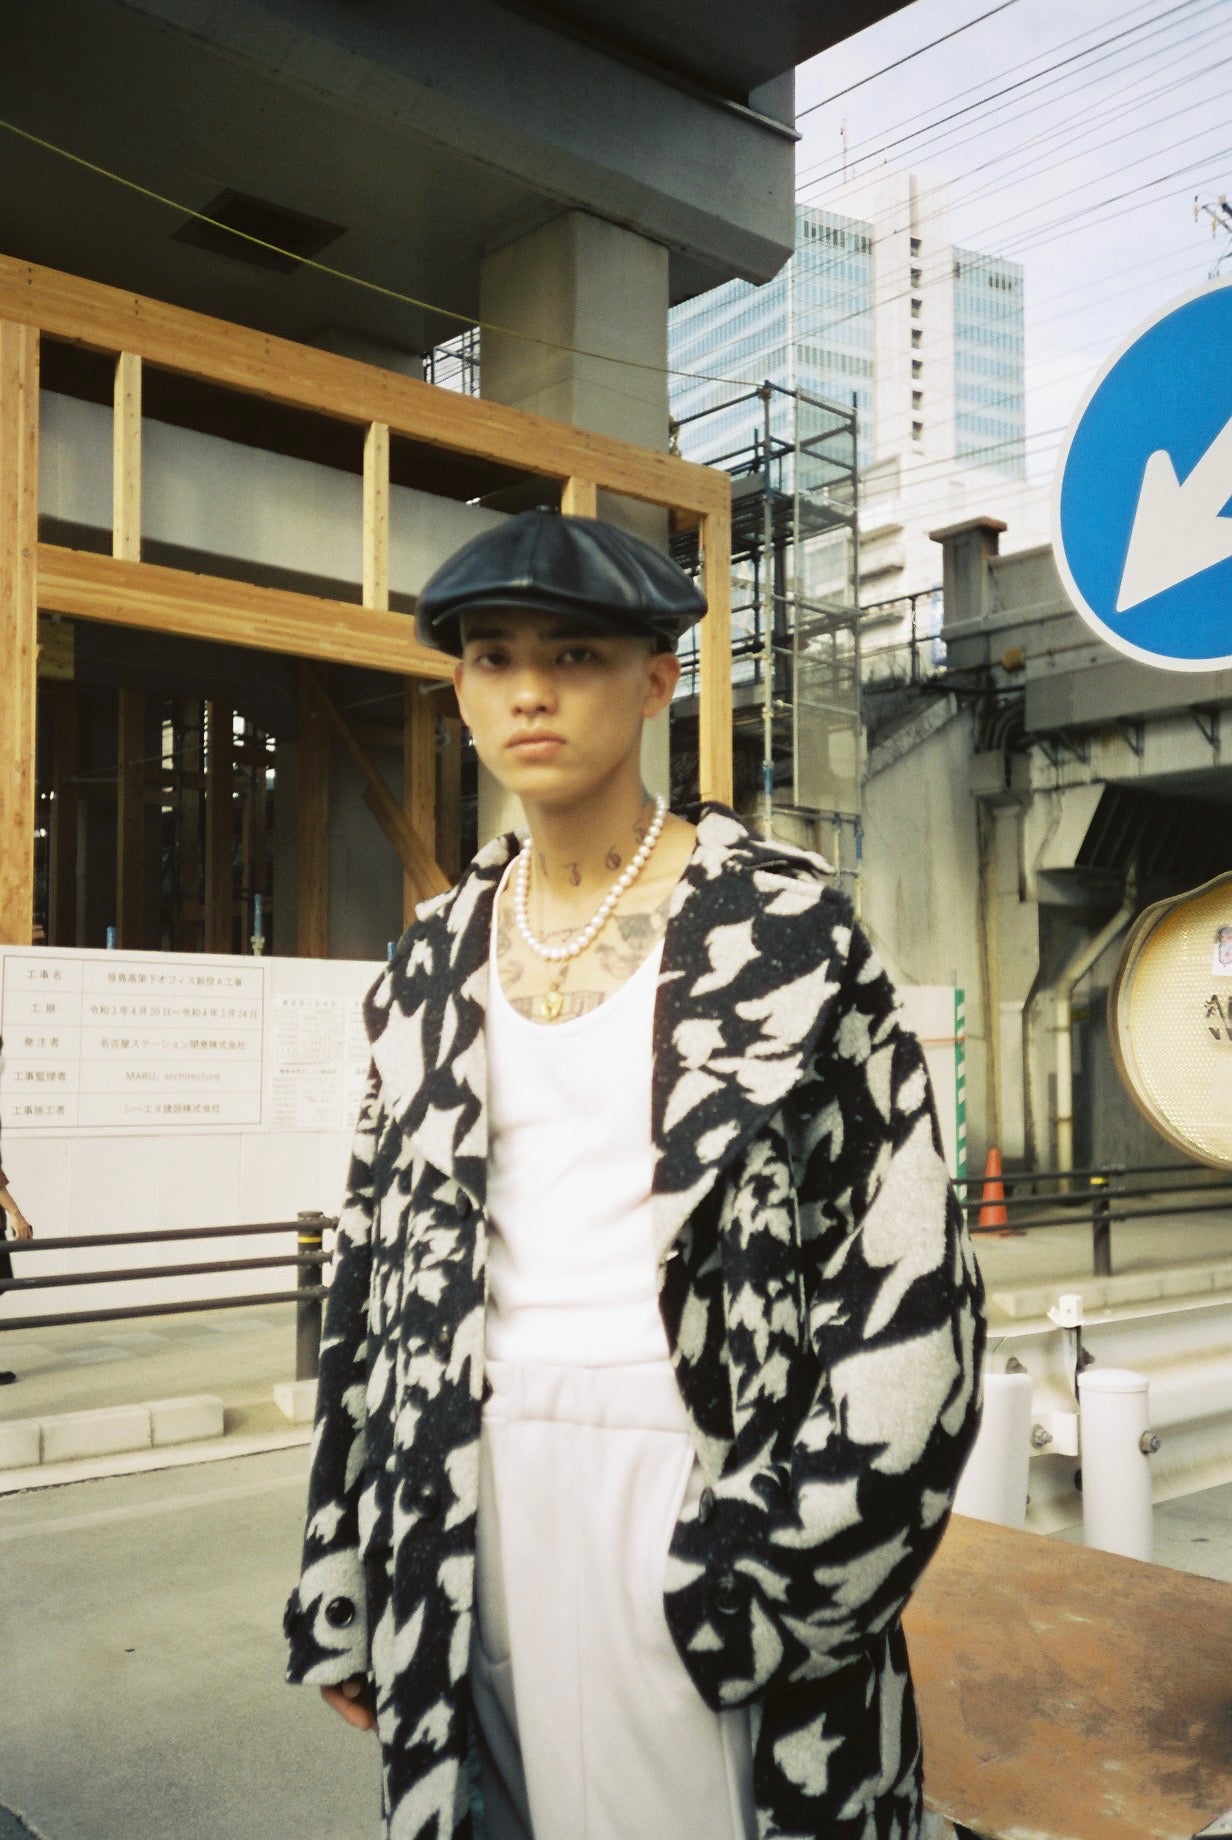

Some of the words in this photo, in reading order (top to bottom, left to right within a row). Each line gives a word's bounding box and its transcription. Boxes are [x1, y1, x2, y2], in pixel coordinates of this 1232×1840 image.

[27, 970, 62, 982] 工事名
[31, 1004, 56, 1014] 工期
[24, 1036, 59, 1048] 発注者
[163, 1071, 221, 1082] architecture
